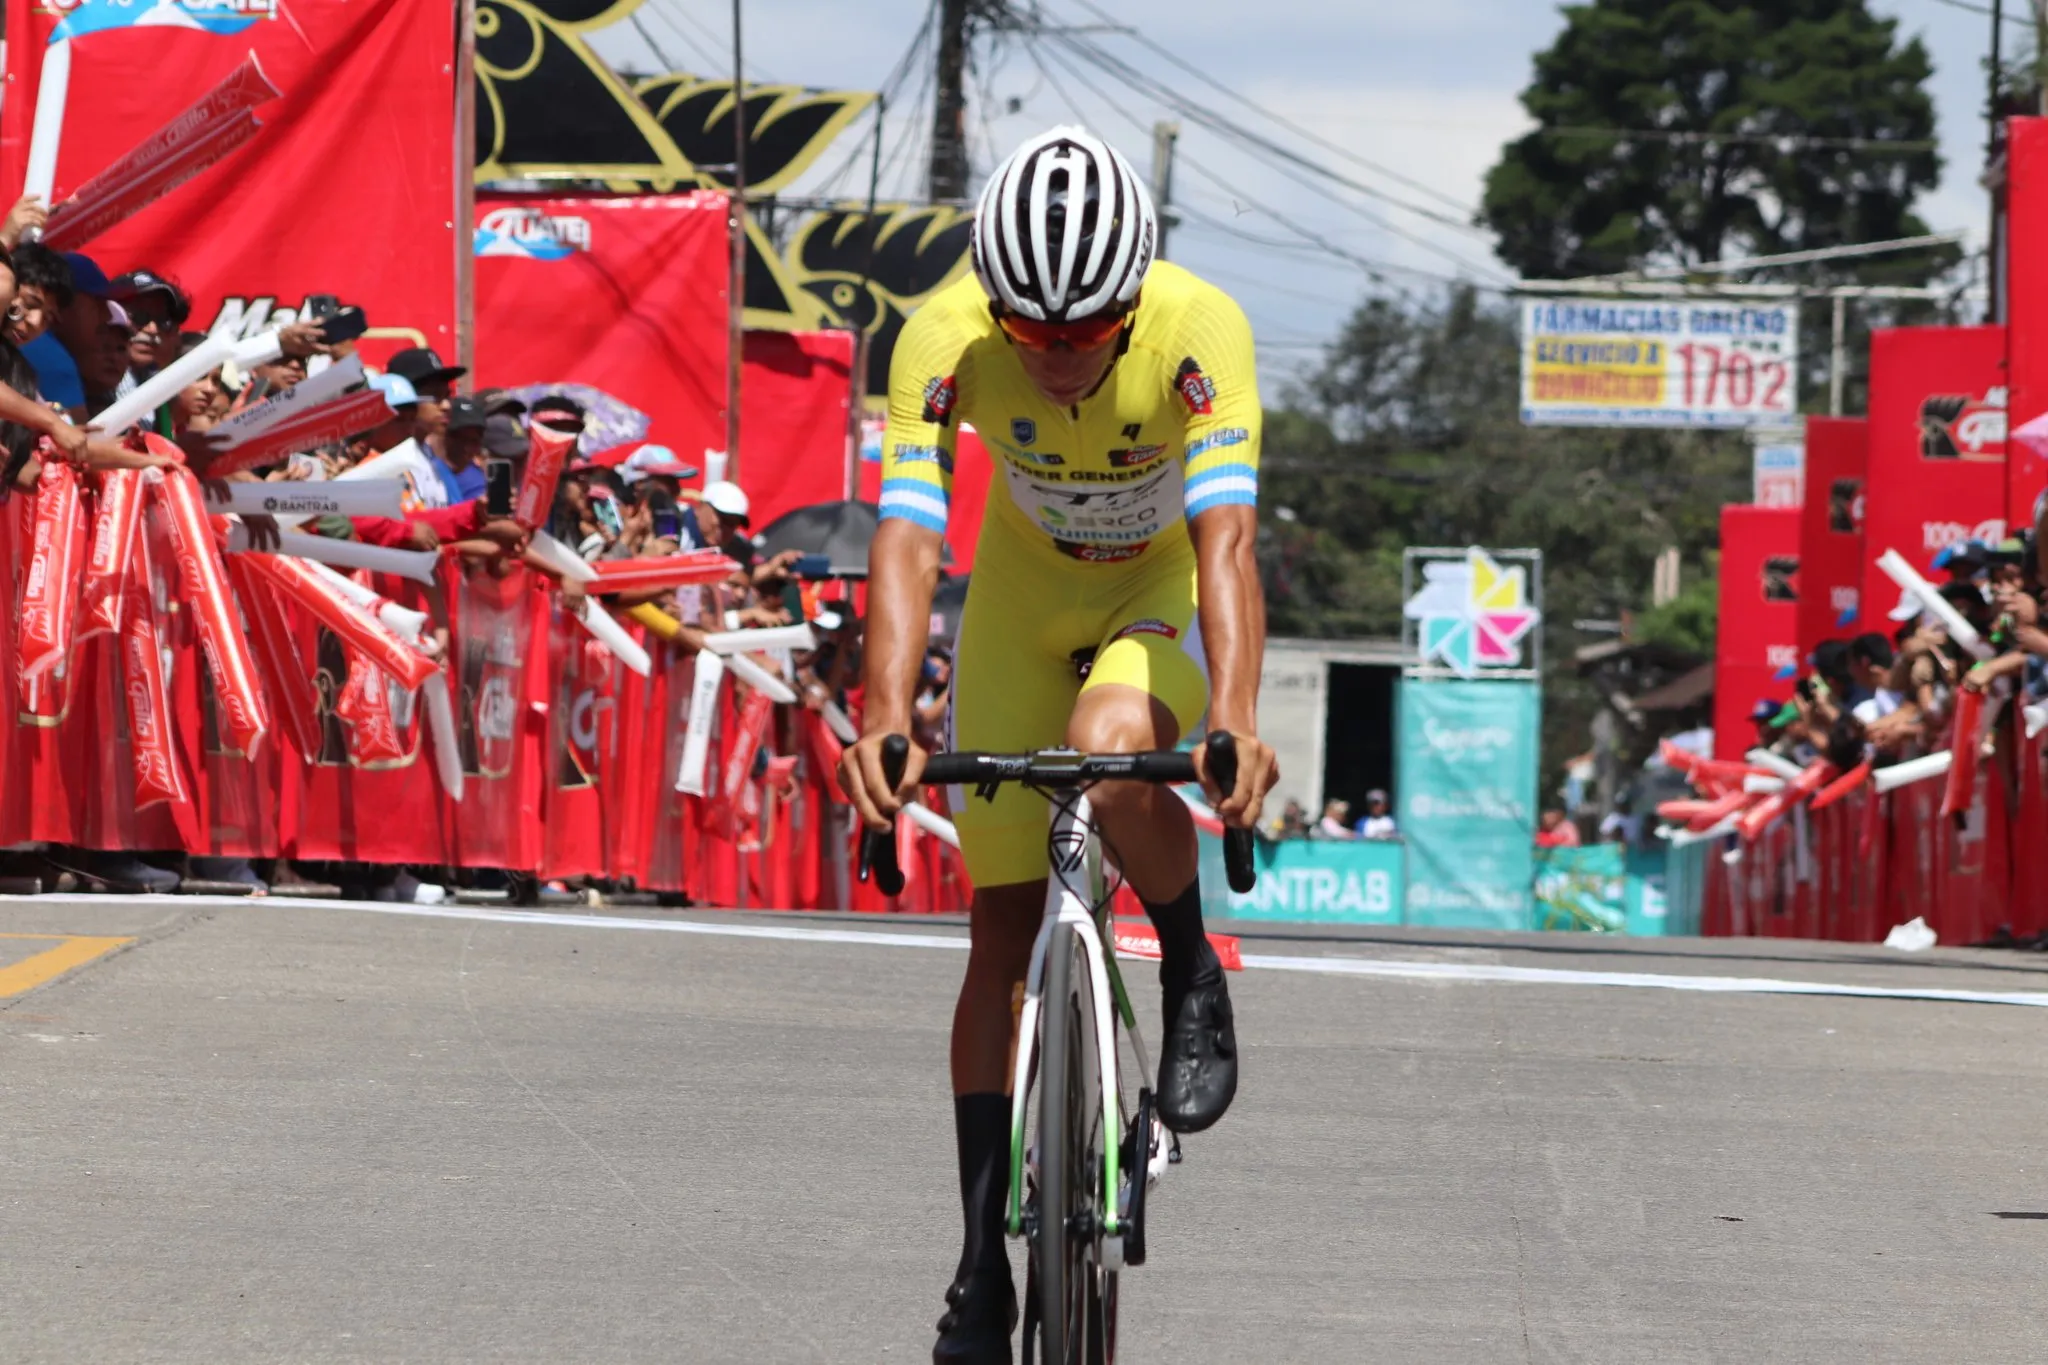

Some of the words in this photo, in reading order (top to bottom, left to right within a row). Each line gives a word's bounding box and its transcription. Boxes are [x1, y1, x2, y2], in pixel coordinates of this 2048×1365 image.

[1534, 305, 1680, 332] FARMACIAS
[1537, 342, 1639, 364] SERVICIO
[1646, 342, 1659, 364] A
[1536, 372, 1659, 401] DOMICILIO
[1674, 342, 1788, 409] 1702
[1069, 456, 1169, 481] GENERAL
[280, 501, 339, 513] BANTRAB
[1040, 521, 1159, 540] SHIMANO
[127, 680, 151, 737] Gallo
[1228, 867, 1391, 913] ANTRAB
